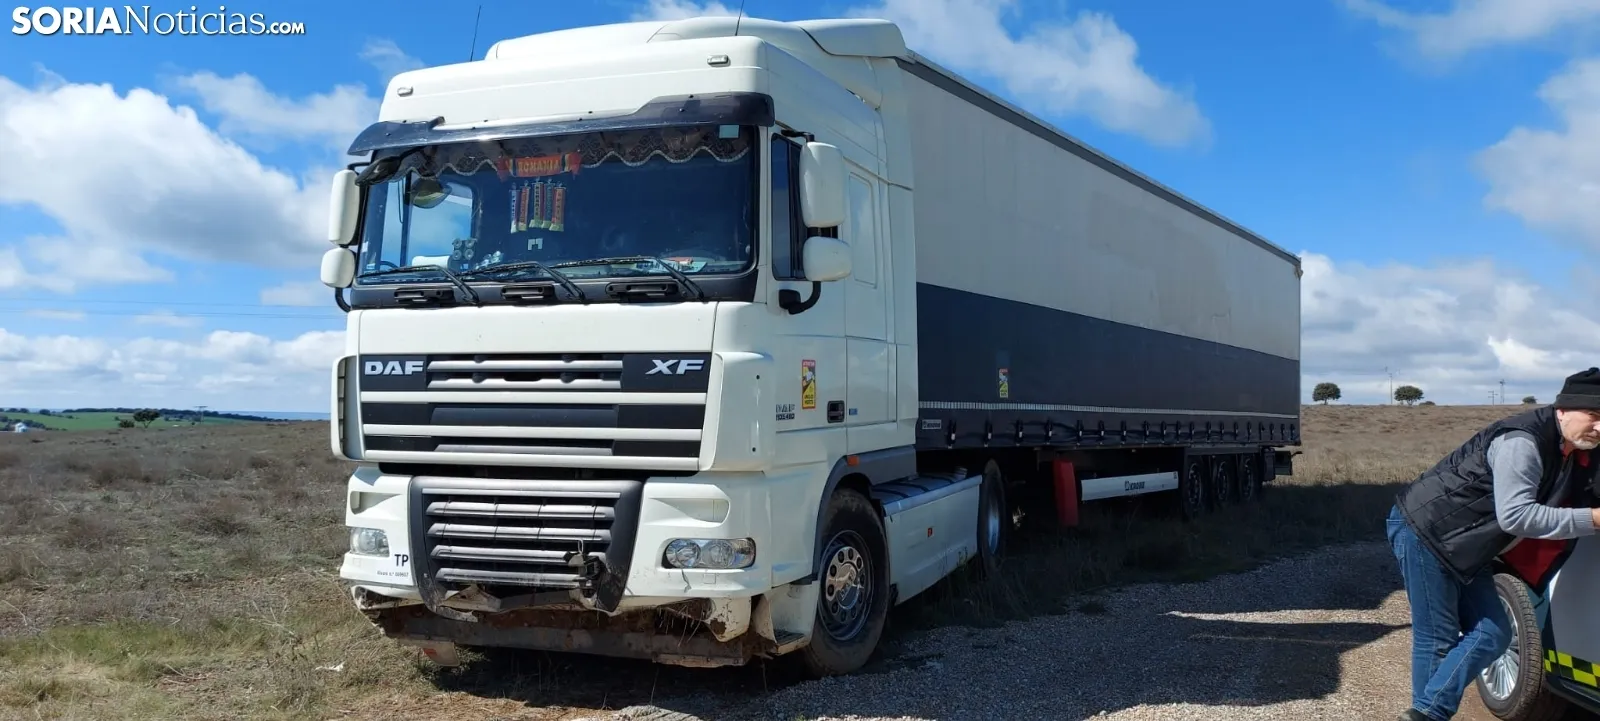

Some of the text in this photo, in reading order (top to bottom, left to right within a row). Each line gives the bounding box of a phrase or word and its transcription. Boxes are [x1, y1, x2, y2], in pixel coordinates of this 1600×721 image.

[364, 360, 424, 376] DAF
[645, 359, 705, 376] XF
[394, 553, 409, 567] TP
